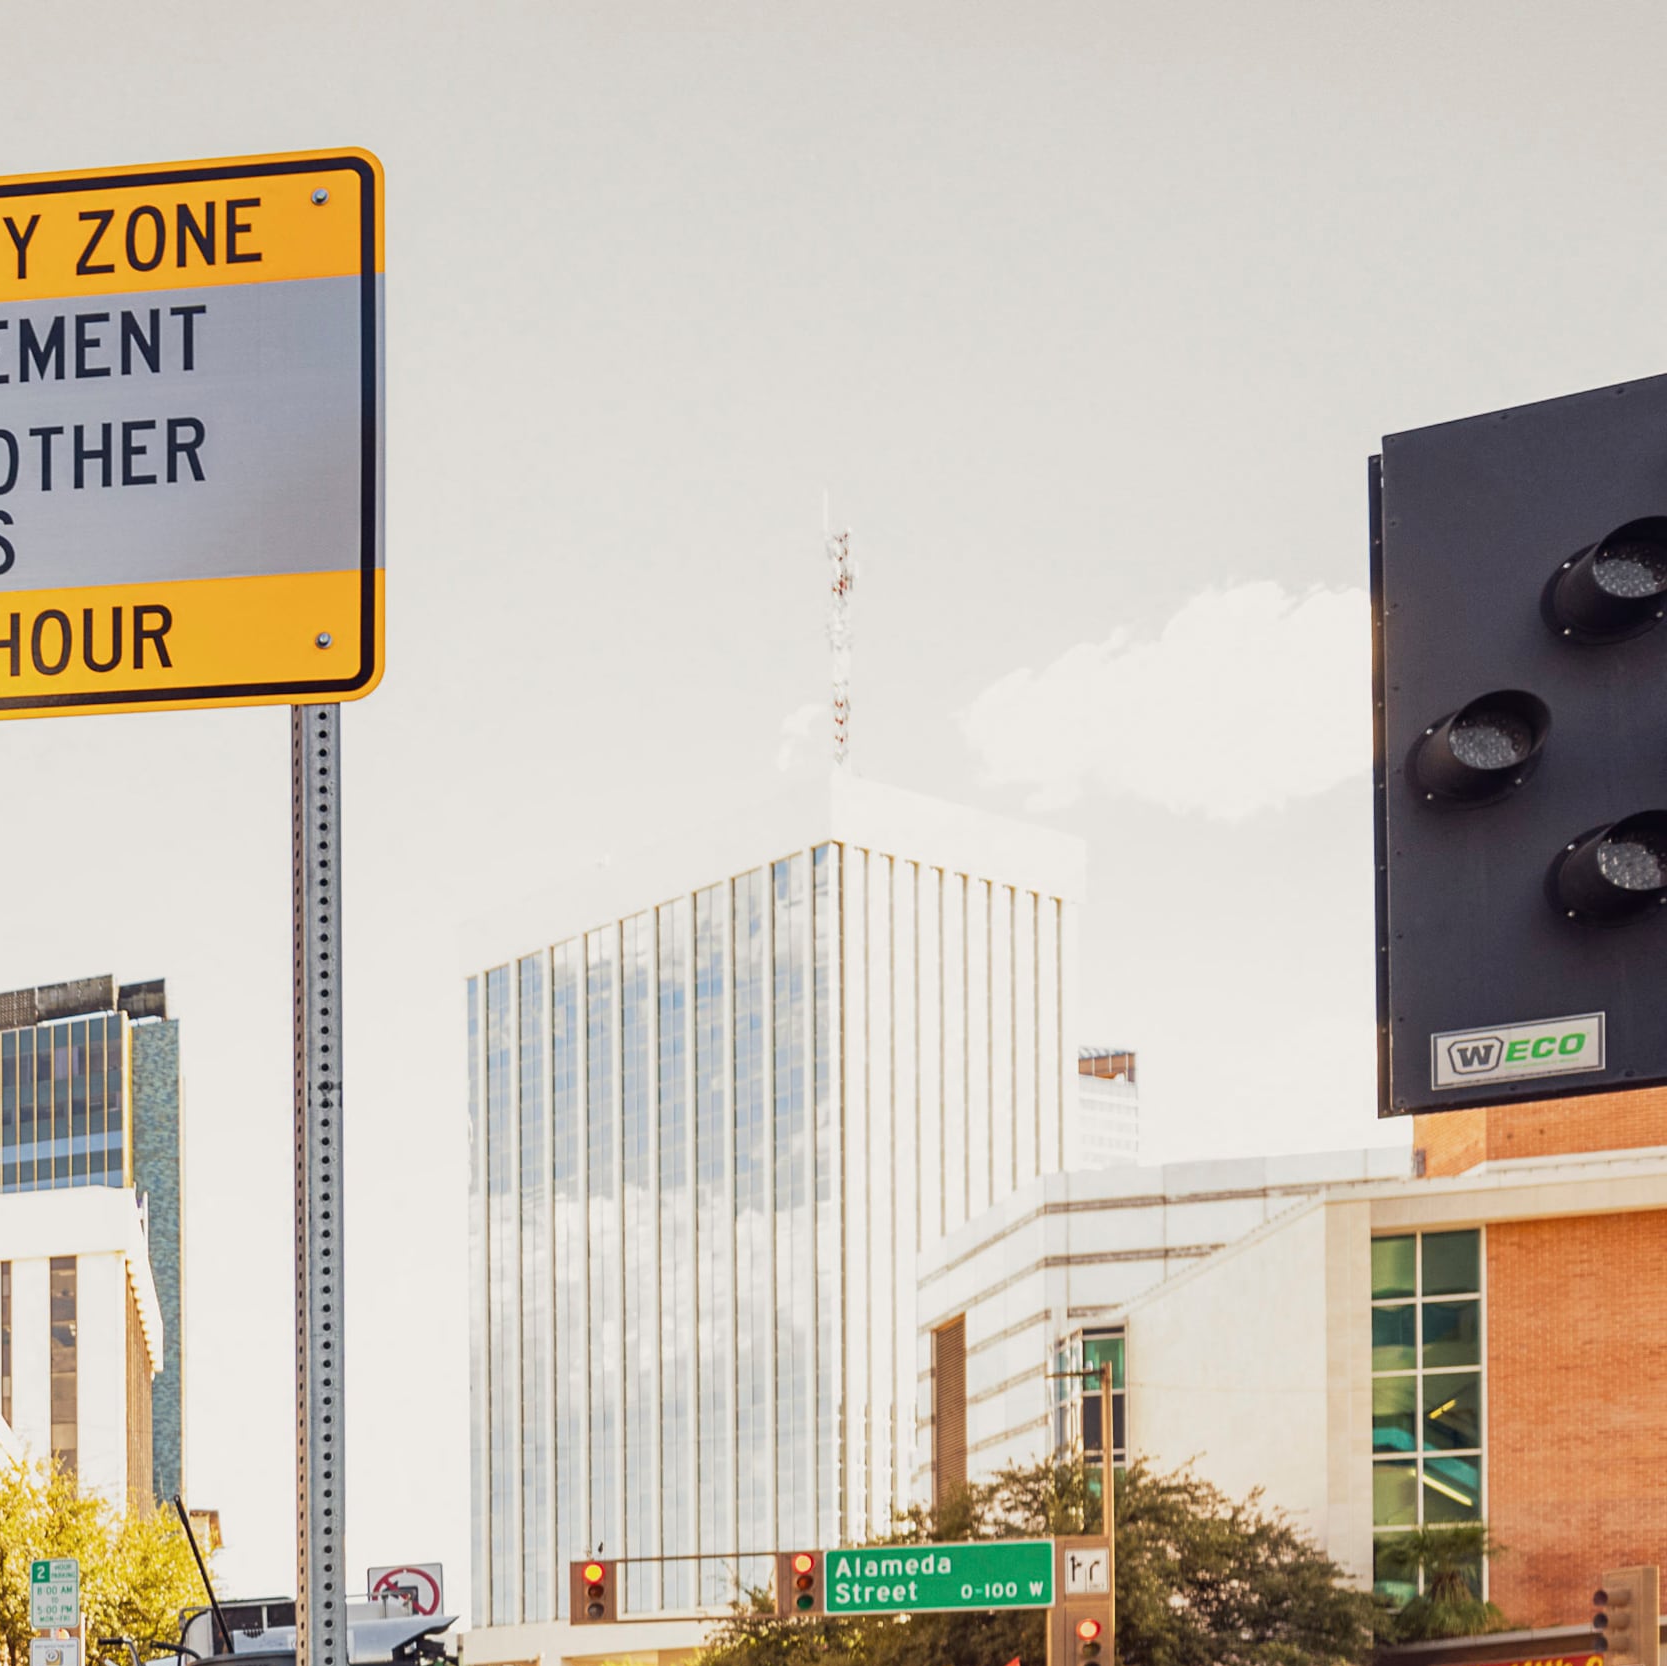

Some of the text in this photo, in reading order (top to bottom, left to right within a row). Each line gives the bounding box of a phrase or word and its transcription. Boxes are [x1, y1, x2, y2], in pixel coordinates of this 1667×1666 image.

[76, 197, 262, 277] ZONE
[36, 1566, 46, 1580] 2
[835, 1553, 952, 1579] Alameda
[835, 1580, 1044, 1604] Street 0-100 W
